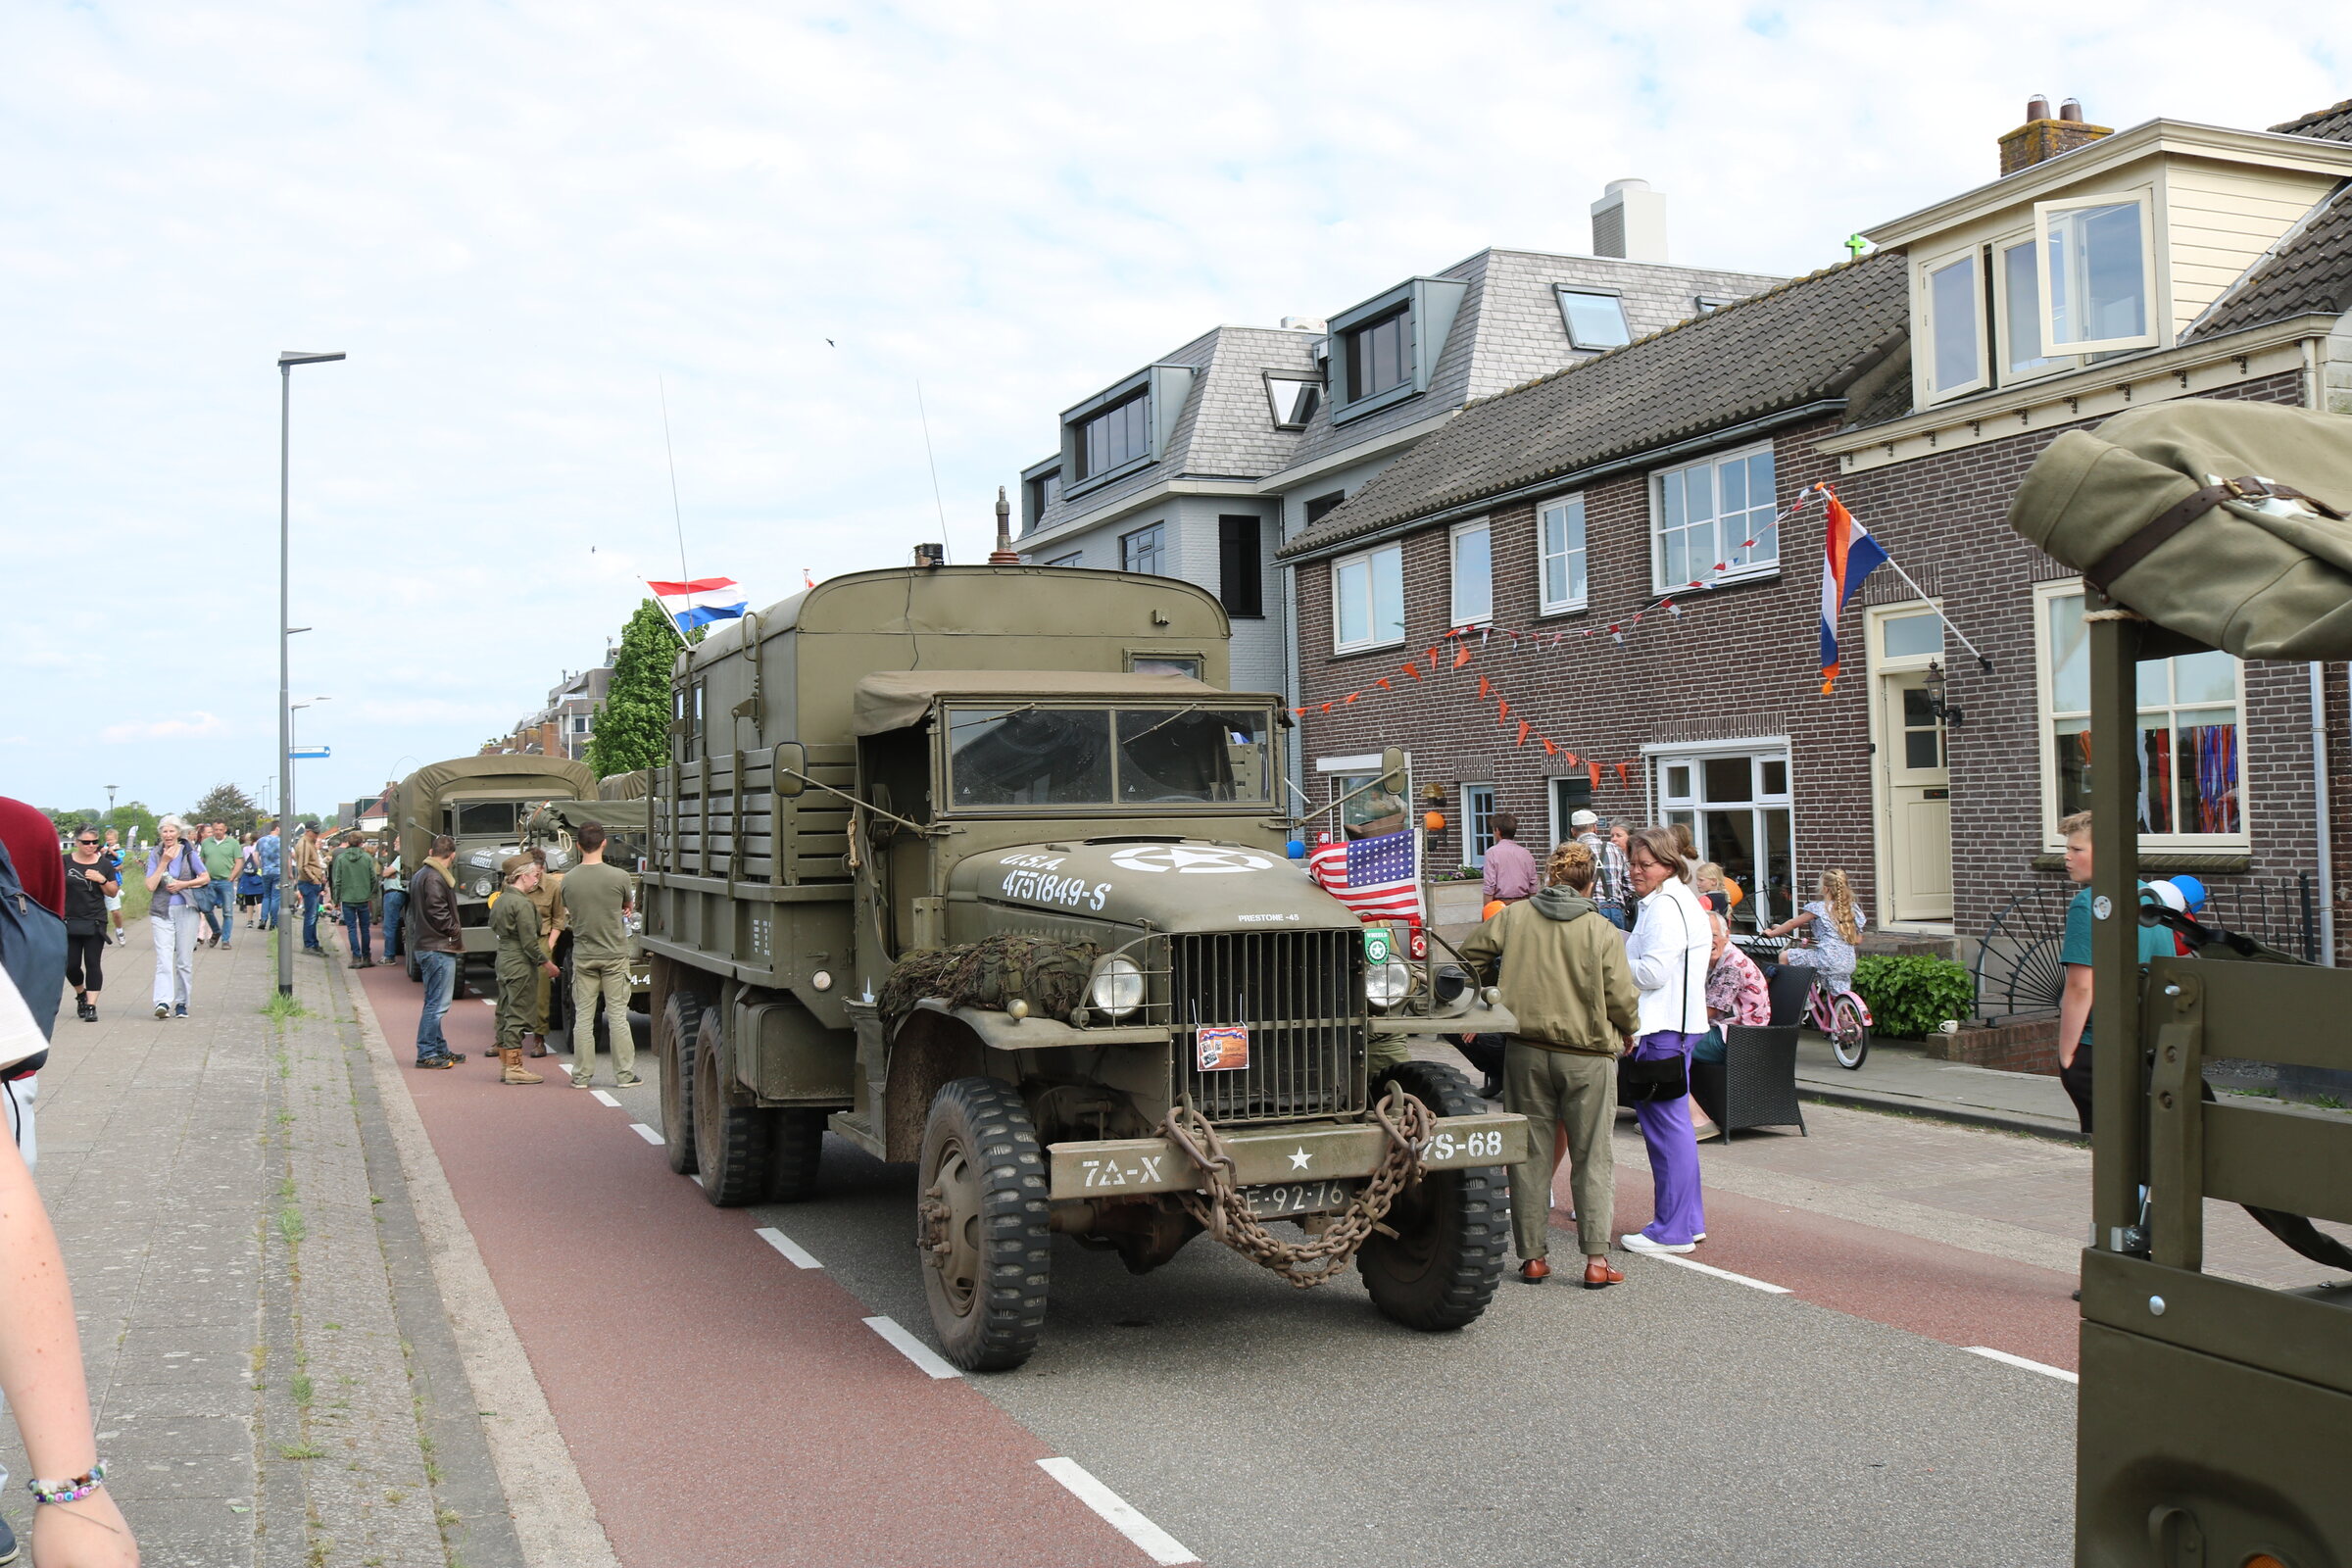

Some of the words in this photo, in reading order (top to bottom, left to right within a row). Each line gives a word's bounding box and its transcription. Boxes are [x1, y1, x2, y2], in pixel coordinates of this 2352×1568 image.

[1000, 854, 1066, 871] U.S.A.
[1002, 869, 1112, 911] 4751849-S
[1238, 913, 1285, 923] PRESTONE
[1235, 1179, 1344, 1215] E-92-76
